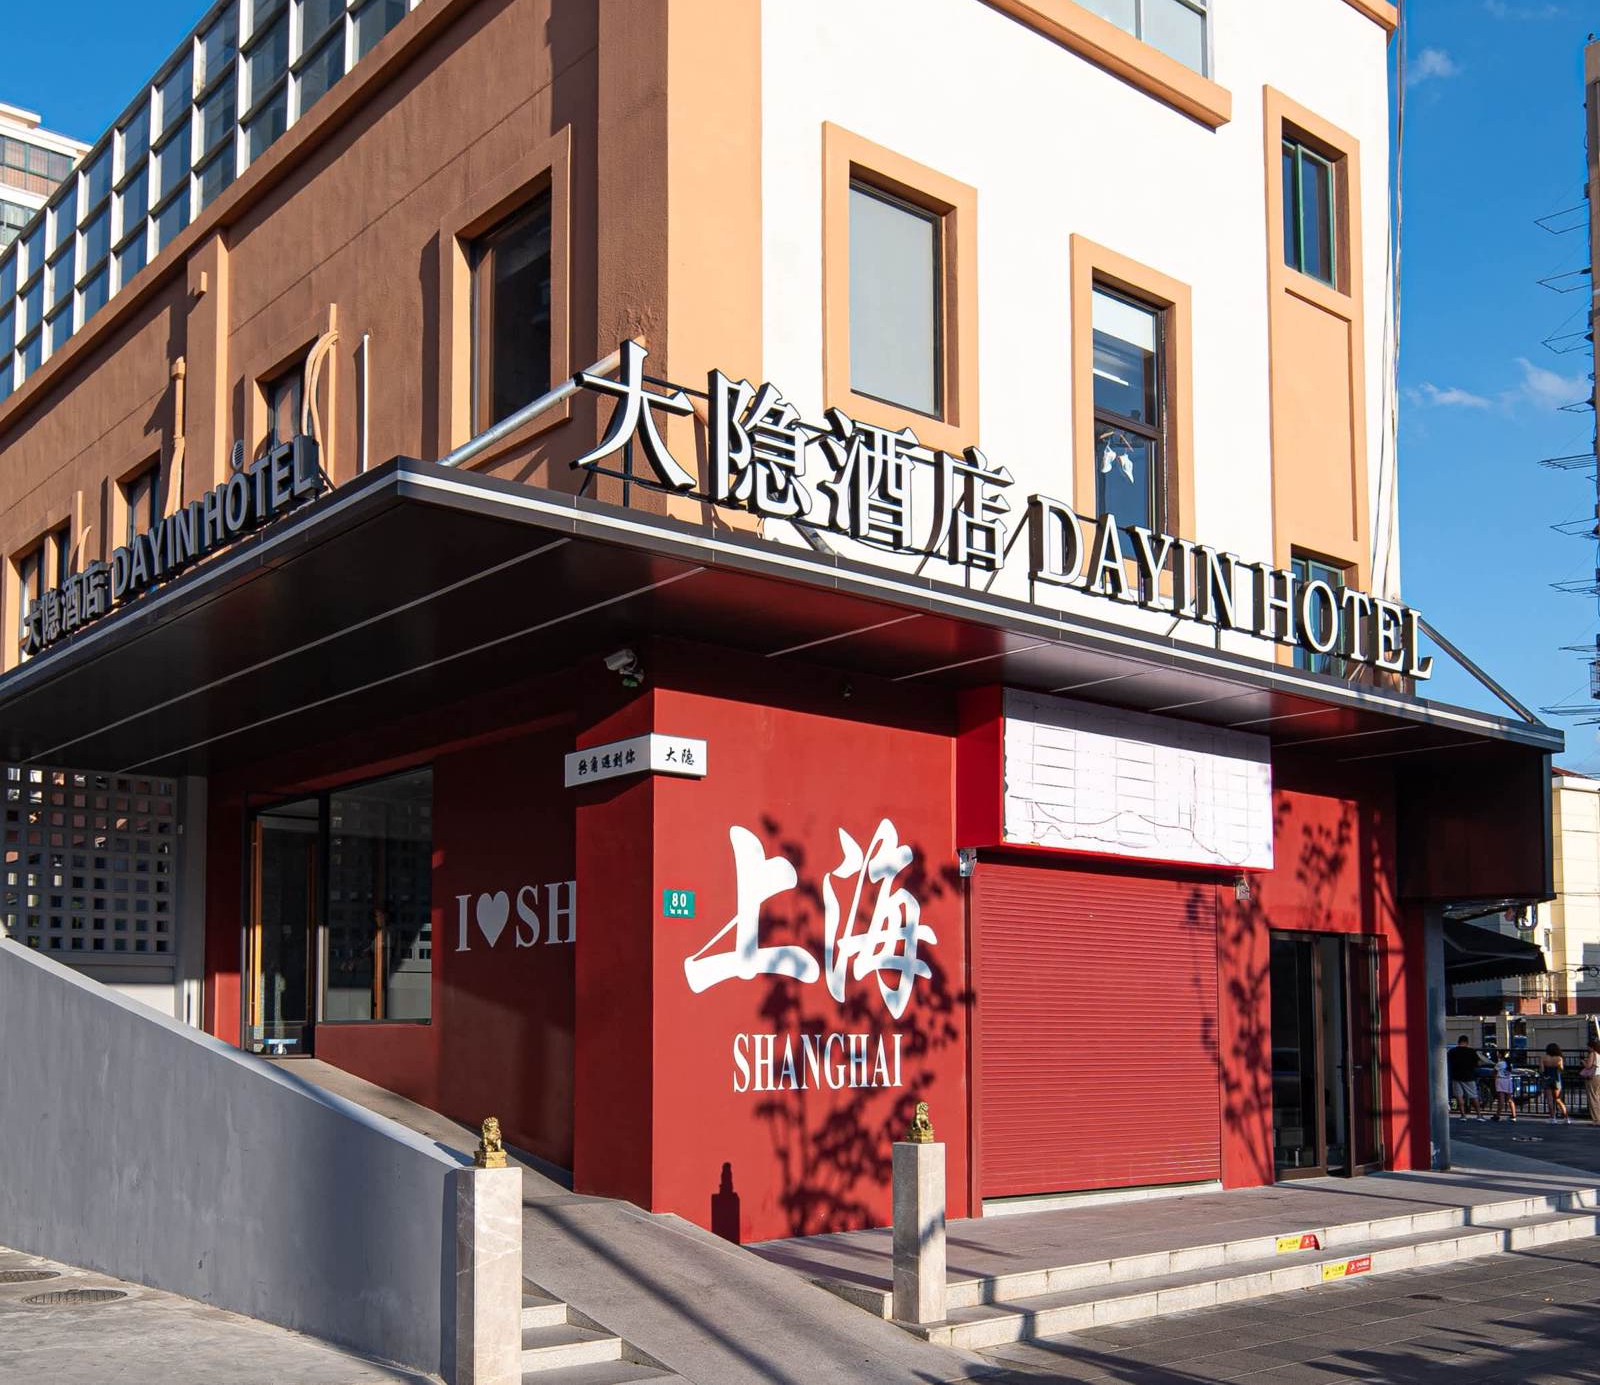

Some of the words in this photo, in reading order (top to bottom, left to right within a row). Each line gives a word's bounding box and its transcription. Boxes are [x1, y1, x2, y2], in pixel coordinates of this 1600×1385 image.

[111, 500, 205, 600] DAYIN
[203, 434, 319, 551] HOTEL
[569, 338, 1015, 571] 大隐酒店
[1028, 493, 1241, 630] DAYIN
[1252, 561, 1433, 681] HOTEL
[664, 746, 695, 766] 大隐
[455, 894, 471, 952] I
[515, 880, 577, 949] SH
[671, 892, 687, 908] 80
[684, 818, 938, 1020] 上海
[732, 1033, 904, 1093] SHANGHAI
